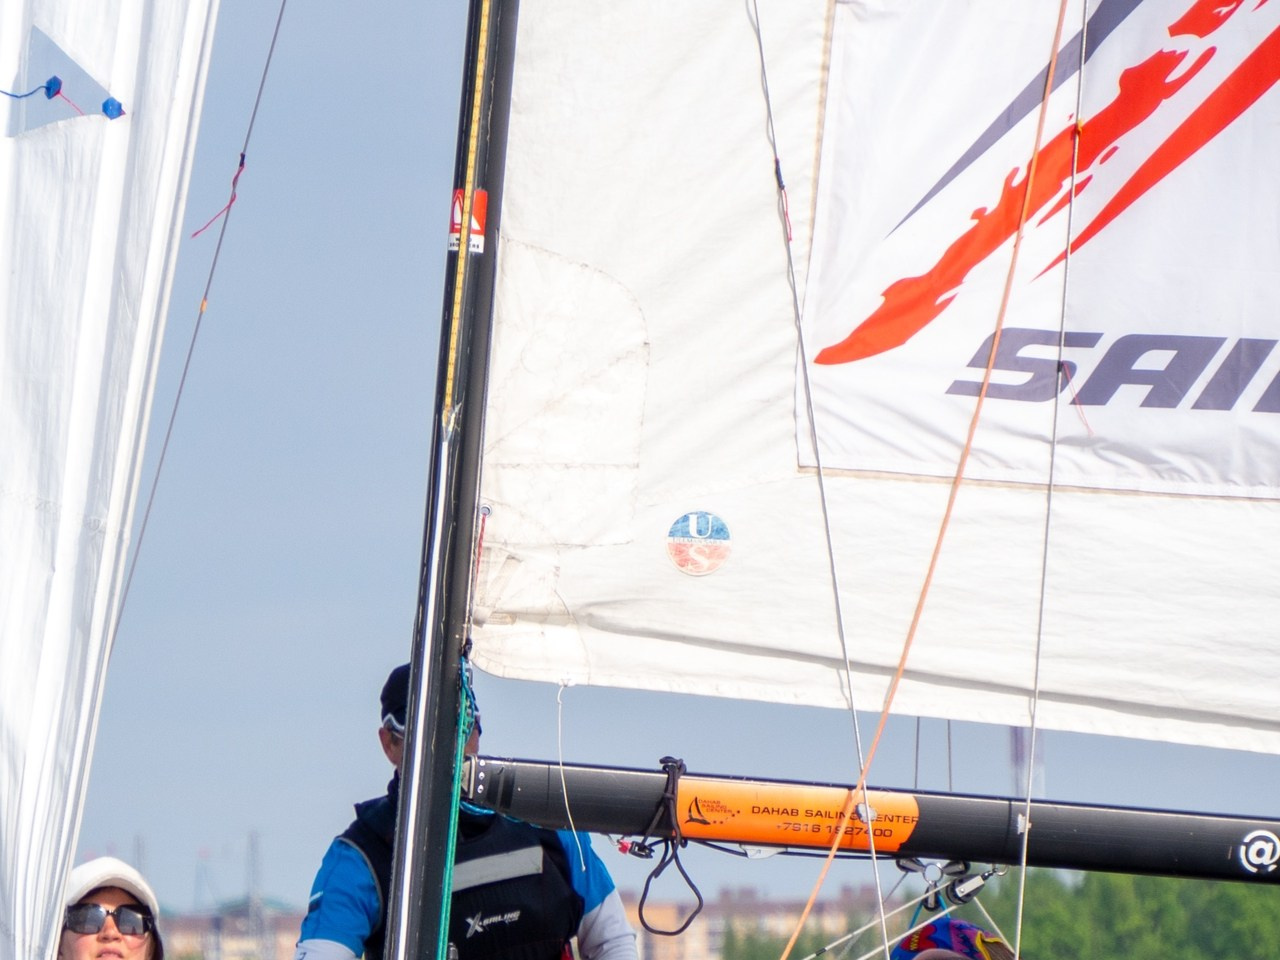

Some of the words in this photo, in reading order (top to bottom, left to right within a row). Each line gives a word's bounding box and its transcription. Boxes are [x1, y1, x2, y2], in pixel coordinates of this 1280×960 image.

[944, 327, 1280, 414] SAI
[688, 513, 713, 538] U
[751, 806, 799, 817] DAHAB
